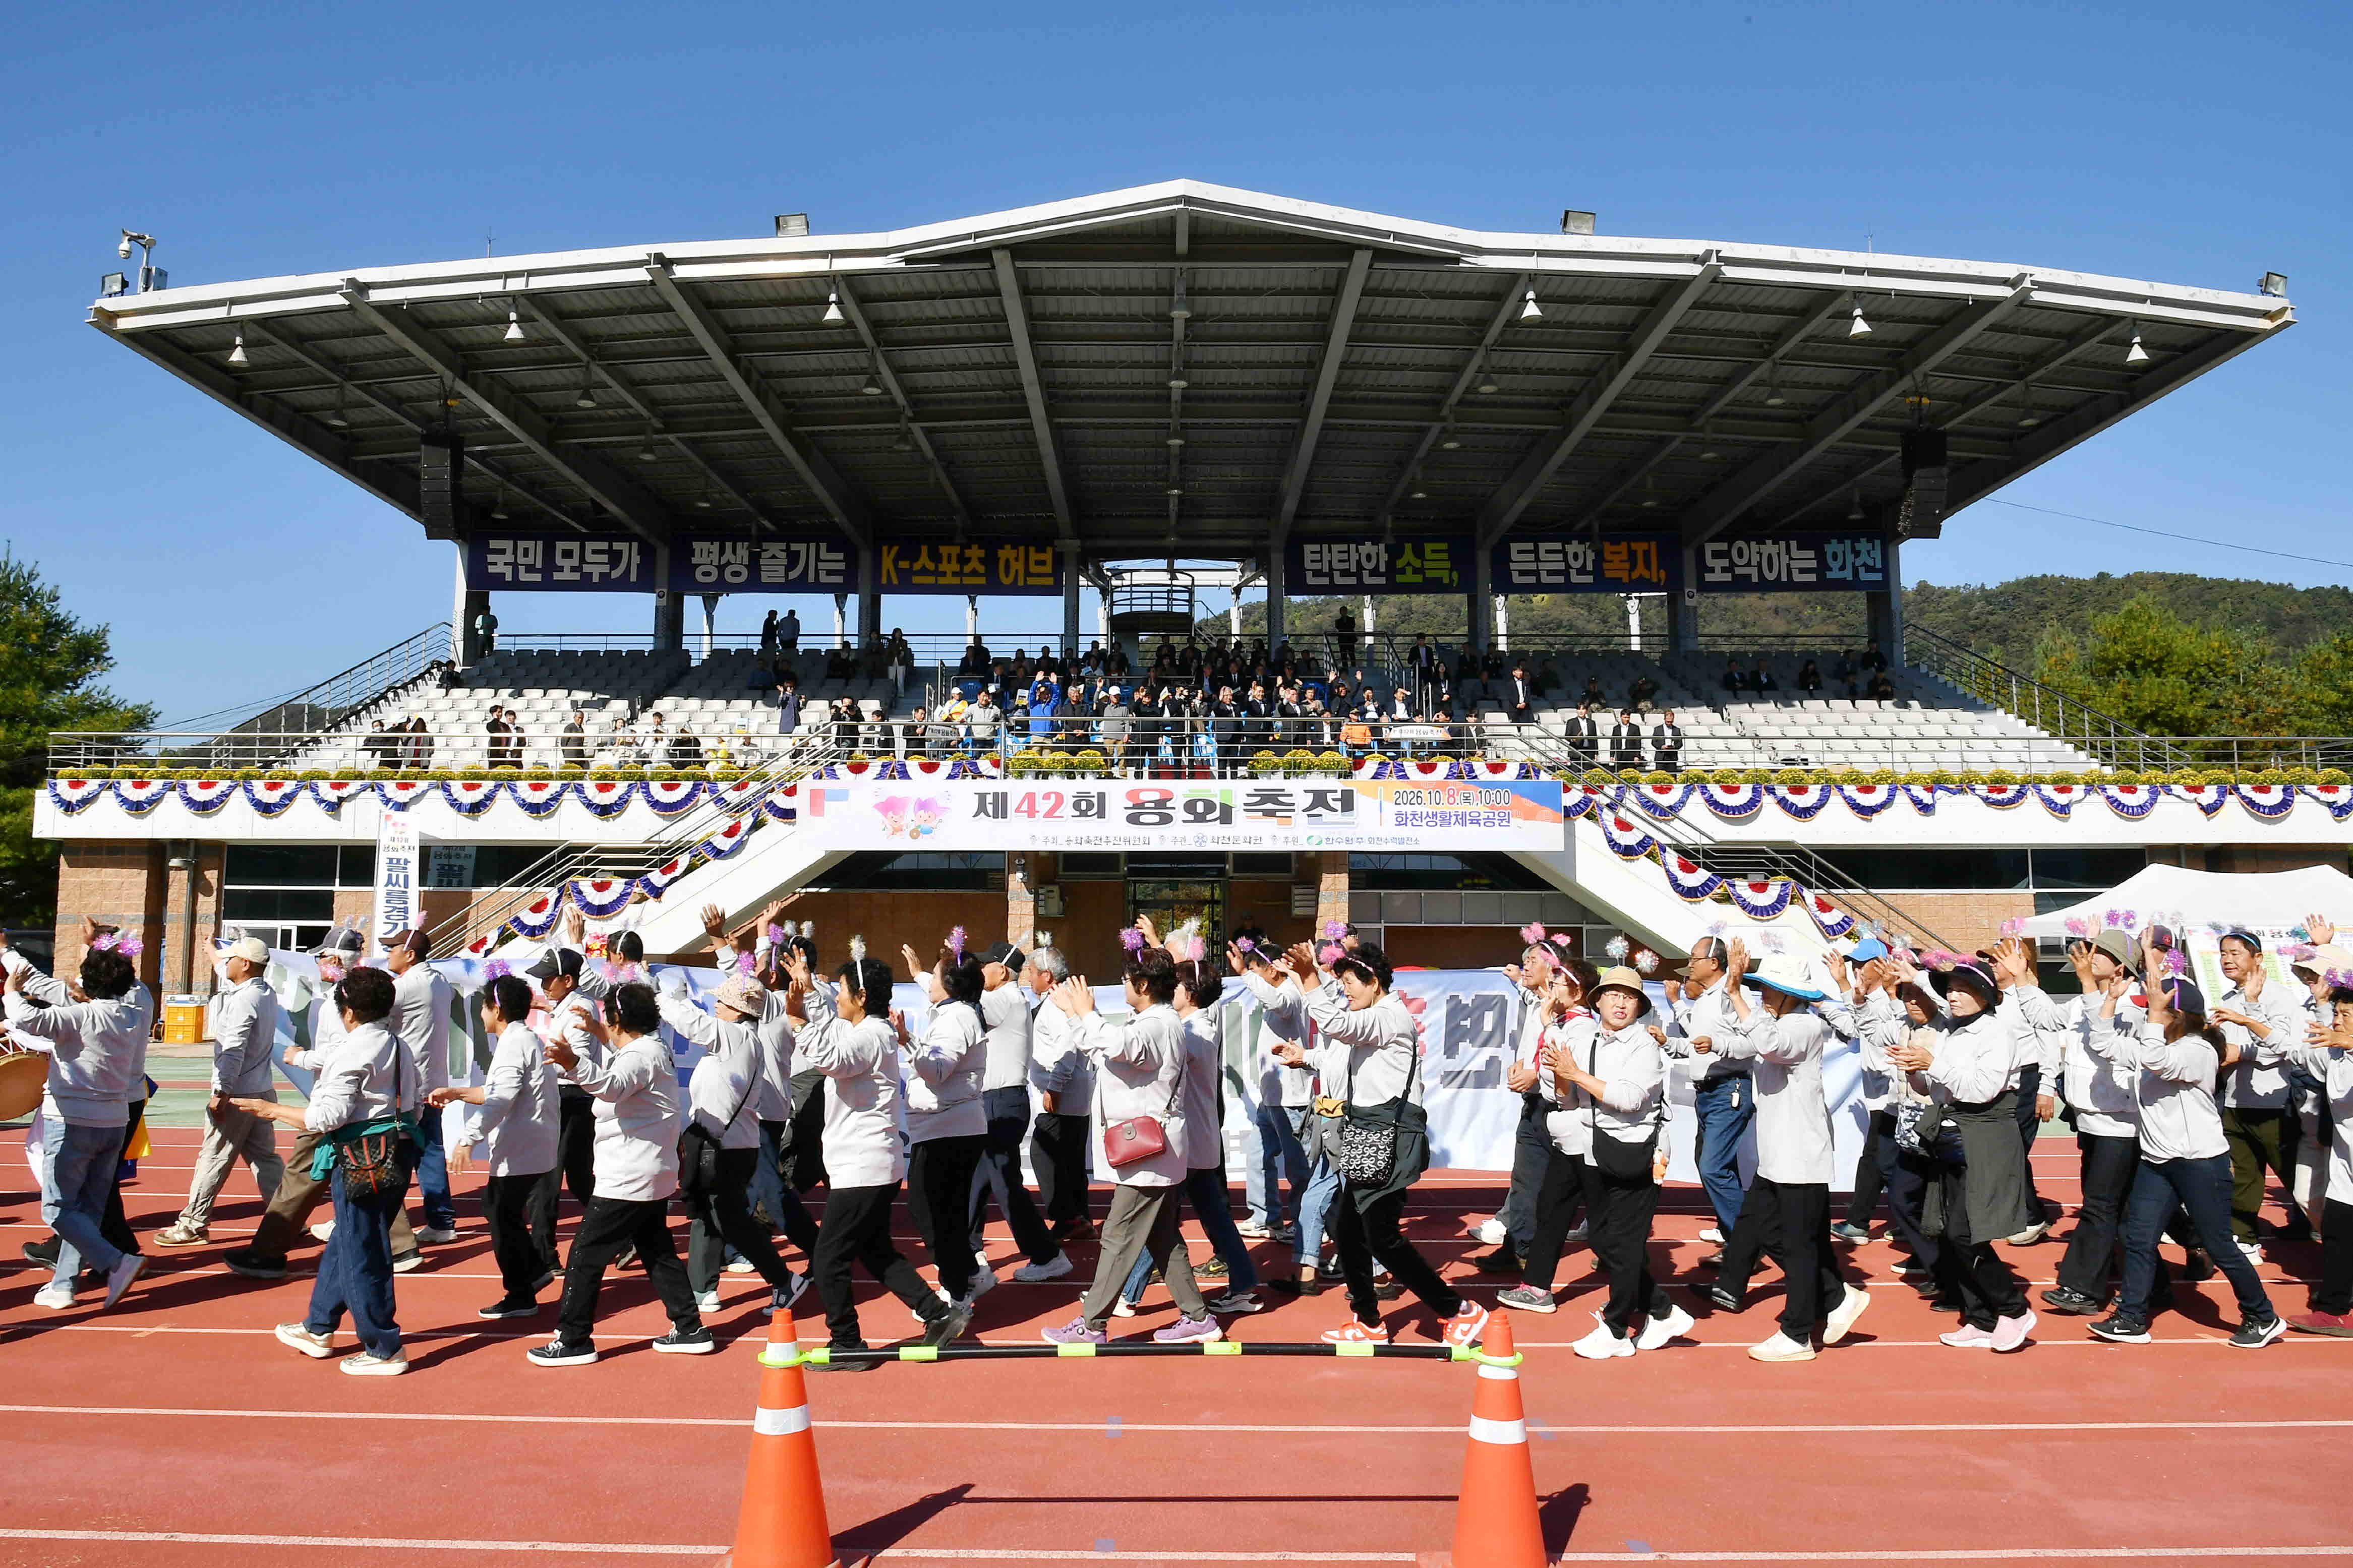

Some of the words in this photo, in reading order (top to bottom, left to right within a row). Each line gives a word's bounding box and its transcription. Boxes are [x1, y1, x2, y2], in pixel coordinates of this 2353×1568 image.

[487, 540, 542, 581] 국민
[553, 541, 640, 582] 모두가
[691, 541, 749, 583] 평생
[759, 542, 846, 583] 즐기는
[880, 545, 986, 584] K-스포츠
[997, 545, 1055, 585] 허브
[1304, 541, 1387, 584] 탄탄한
[1396, 542, 1459, 586] 소득,
[1510, 540, 1595, 583] 든든한
[1603, 541, 1666, 585] 복지,
[1704, 540, 1817, 582] 도약하는
[1824, 538, 1883, 581] 화천
[972, 791, 1106, 819] 제42회
[1123, 788, 1356, 826] 용화축전
[1394, 811, 1511, 827] 화천생활체육공원
[1210, 835, 1263, 845] 화천문화원
[383, 857, 411, 952] 팔씨름경기
